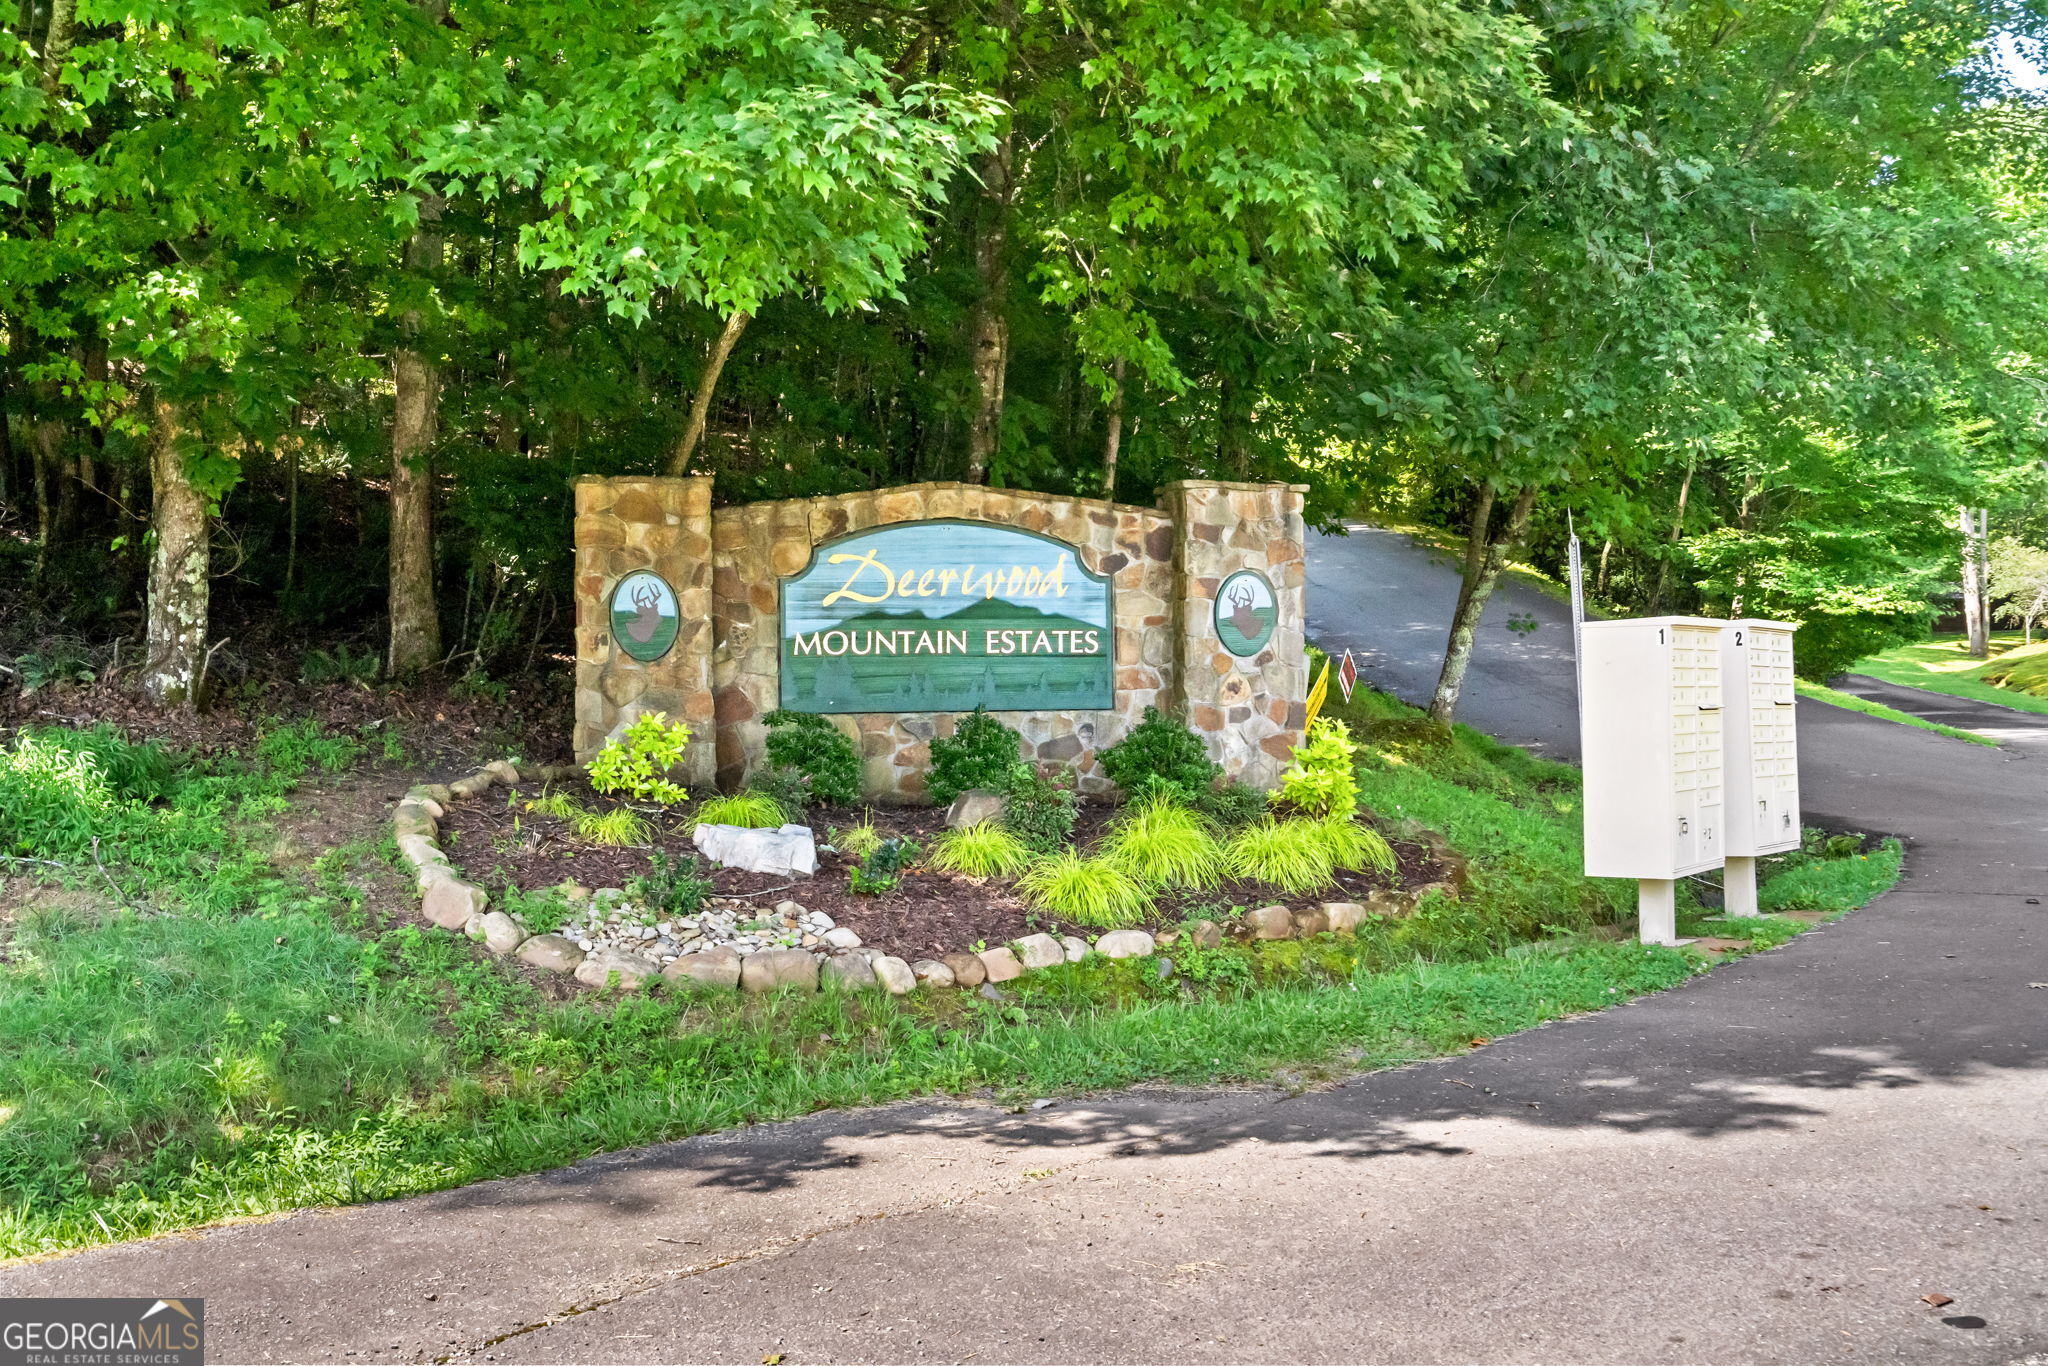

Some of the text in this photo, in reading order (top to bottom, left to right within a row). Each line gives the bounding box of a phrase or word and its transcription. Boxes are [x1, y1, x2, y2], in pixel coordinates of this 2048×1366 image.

[822, 549, 1070, 607] Deerwood
[793, 630, 1099, 656] MOUNTAIN ESTATES
[1659, 629, 1665, 645] 1
[1735, 632, 1743, 646] 2
